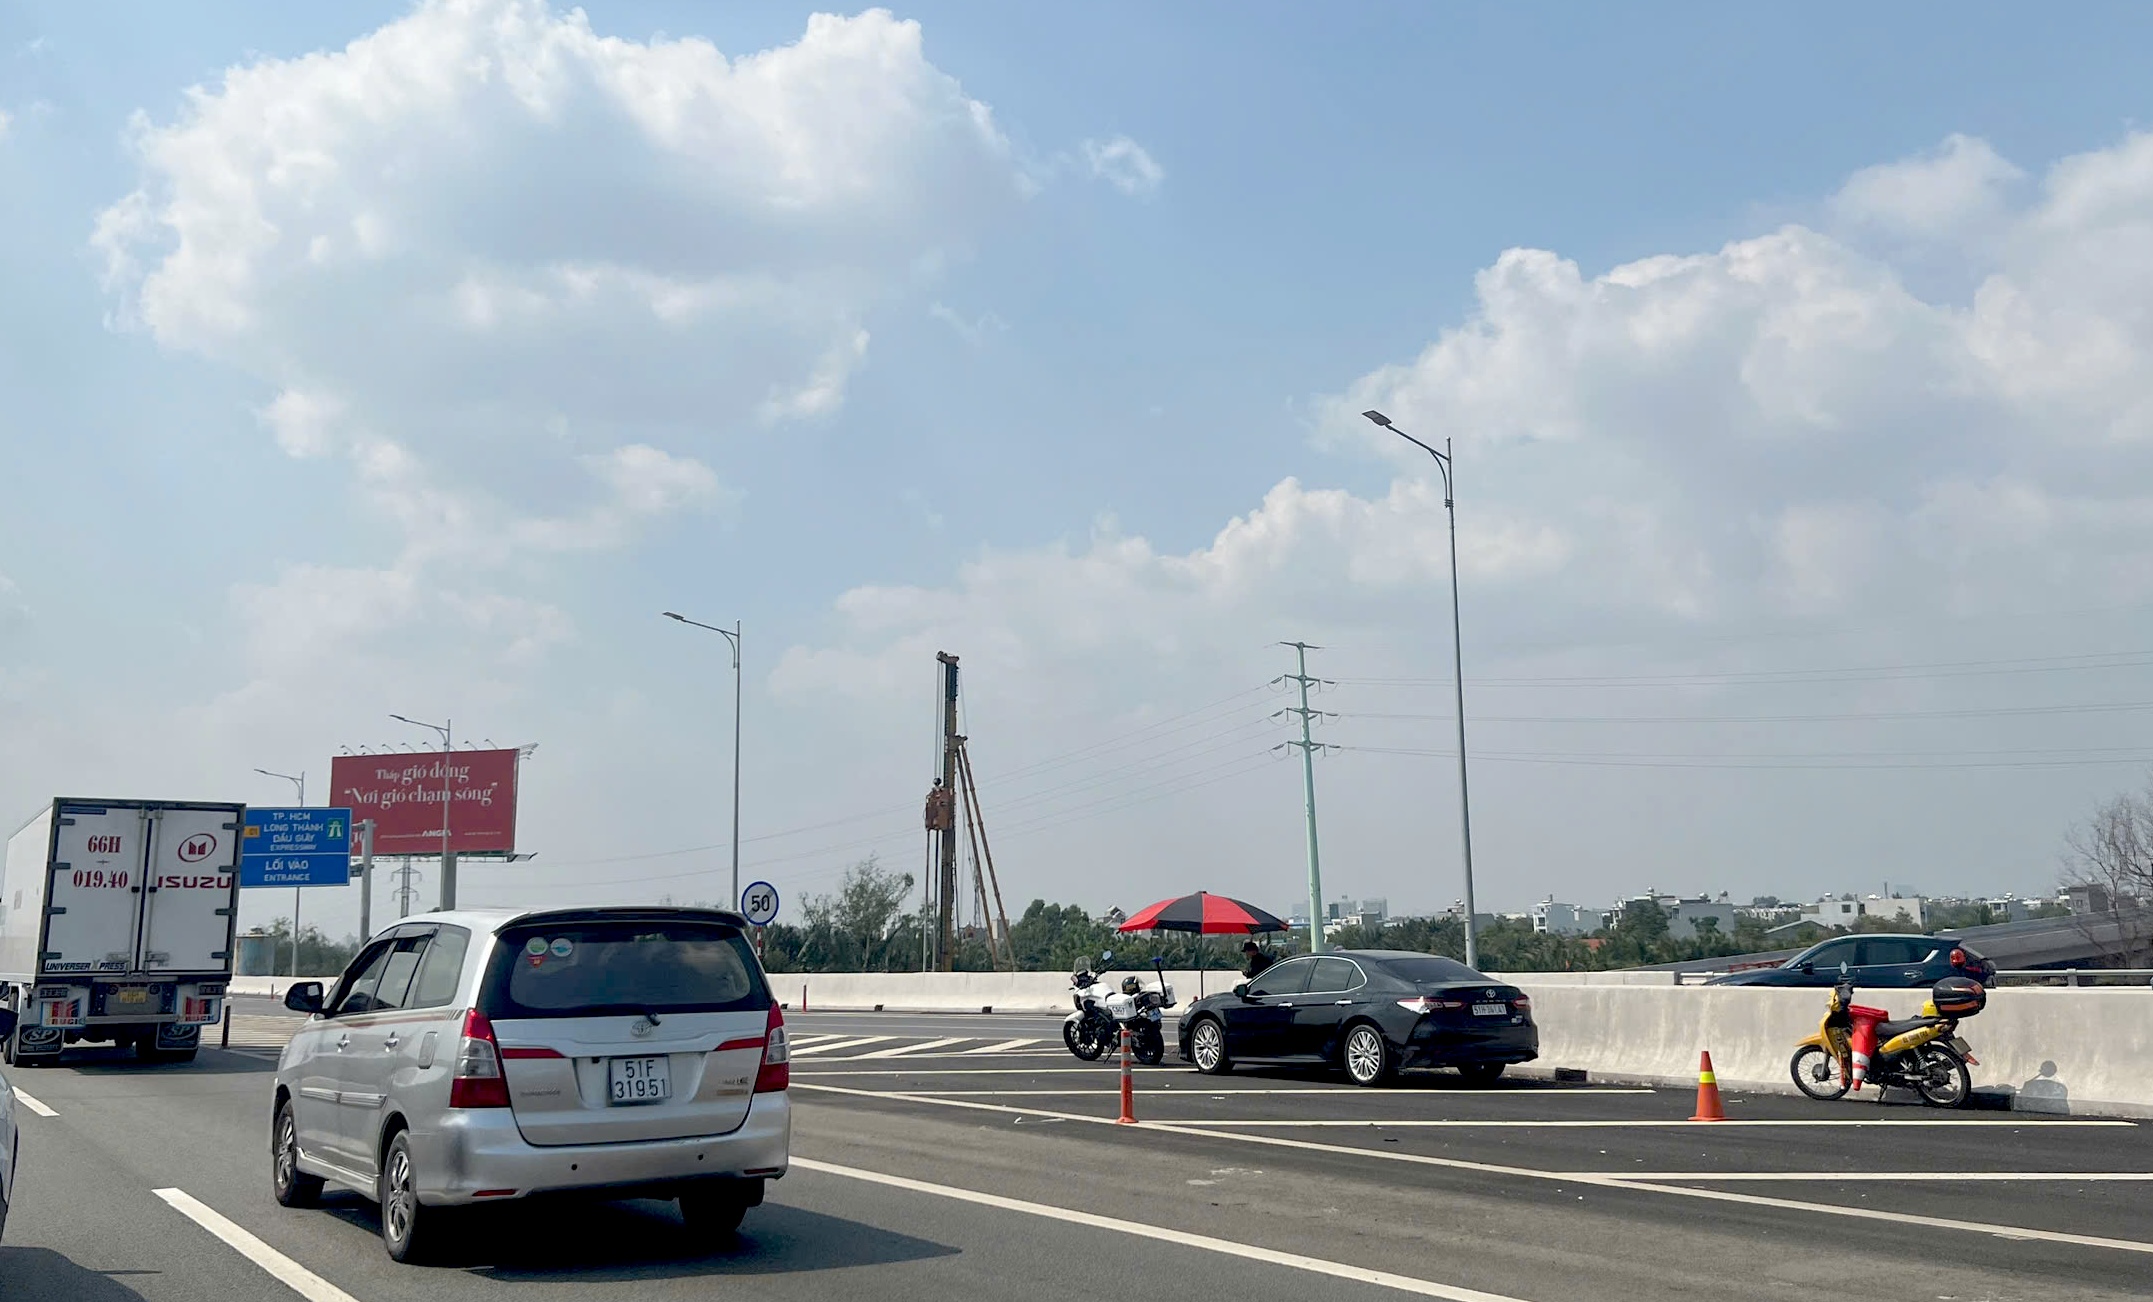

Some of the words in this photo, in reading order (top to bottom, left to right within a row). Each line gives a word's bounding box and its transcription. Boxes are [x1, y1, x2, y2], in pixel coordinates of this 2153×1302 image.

[375, 768, 400, 783] Tháp
[401, 764, 427, 786] gió
[380, 788, 406, 810] gió
[408, 784, 451, 806] chạm
[272, 812, 287, 821] TP.
[289, 812, 311, 820] HCM
[263, 823, 289, 832] LONG
[292, 821, 324, 832] THÀNH
[87, 834, 122, 853] 66H
[270, 843, 317, 852] EXPRESSWAY
[265, 857, 284, 871] LỐI
[287, 857, 309, 870] VÀO
[73, 869, 128, 889] 019.40
[157, 875, 232, 889] ISUZU
[263, 873, 311, 882] ENTRANCE
[751, 894, 771, 913] 50
[625, 1060, 655, 1079] 51F
